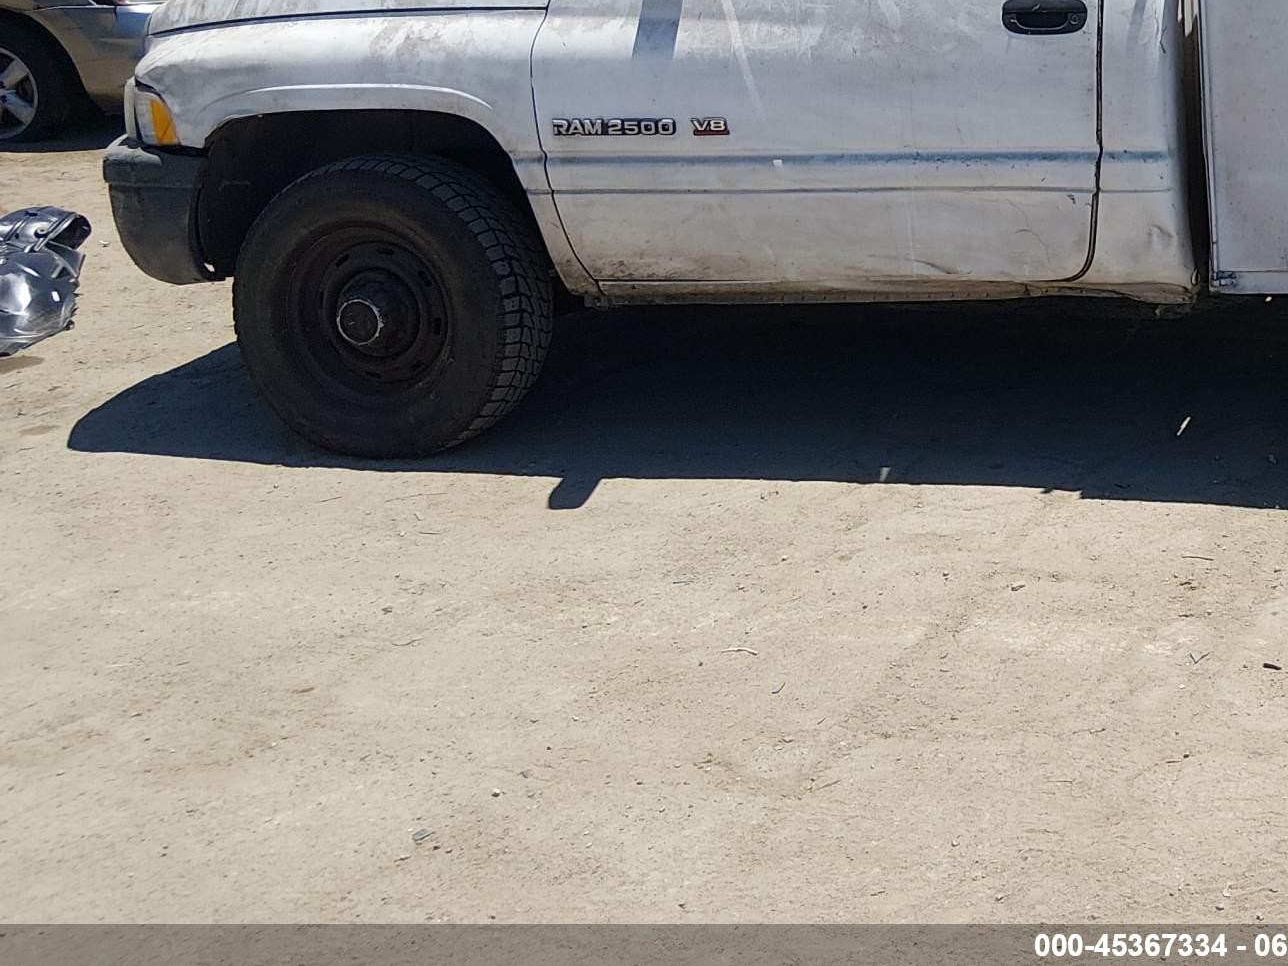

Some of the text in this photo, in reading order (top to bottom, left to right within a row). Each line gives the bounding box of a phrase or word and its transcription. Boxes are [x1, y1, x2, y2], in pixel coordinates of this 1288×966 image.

[551, 118, 676, 136] RAM 2500
[690, 117, 729, 134] V8
